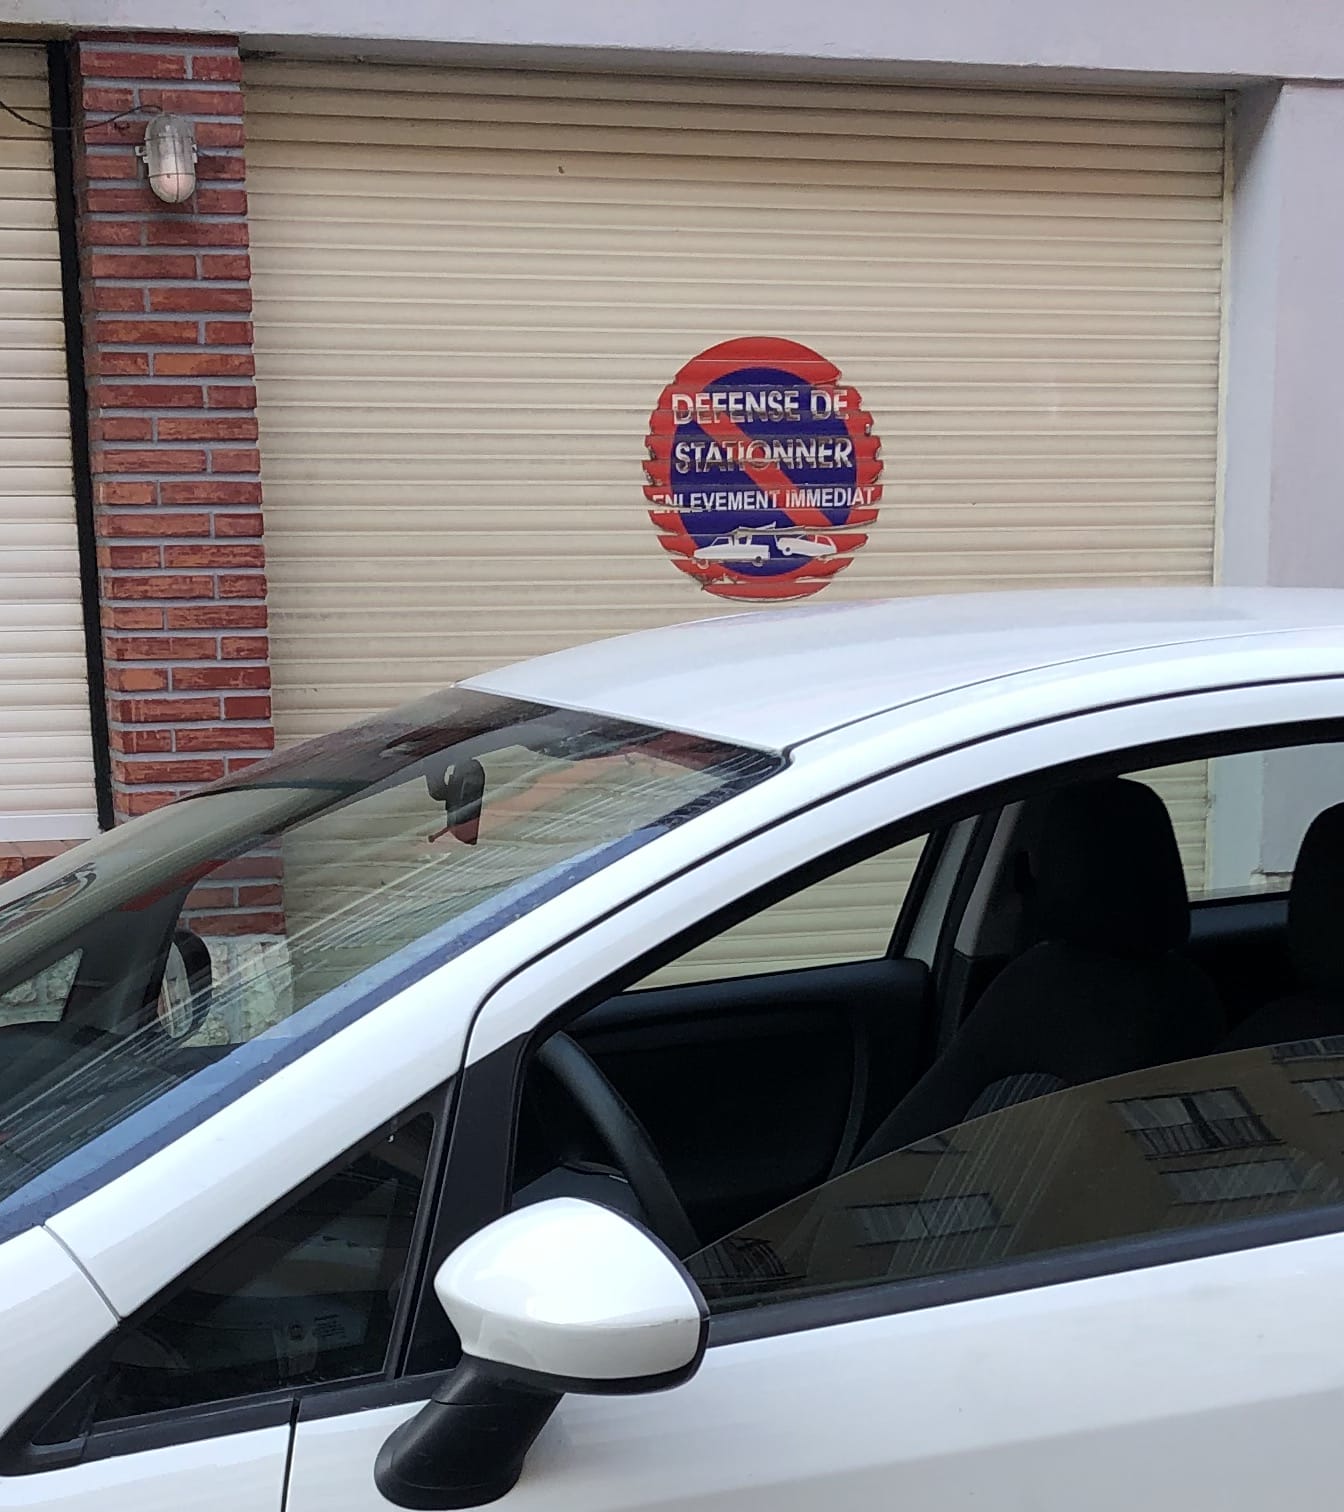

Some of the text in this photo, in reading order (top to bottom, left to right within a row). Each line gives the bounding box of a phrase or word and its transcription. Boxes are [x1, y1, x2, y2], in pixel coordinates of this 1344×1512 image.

[671, 389, 850, 425] DEFENSE DE
[674, 436, 853, 473] STATIONNER
[652, 486, 876, 514] ENLEVEMENT IMMEDIAT
